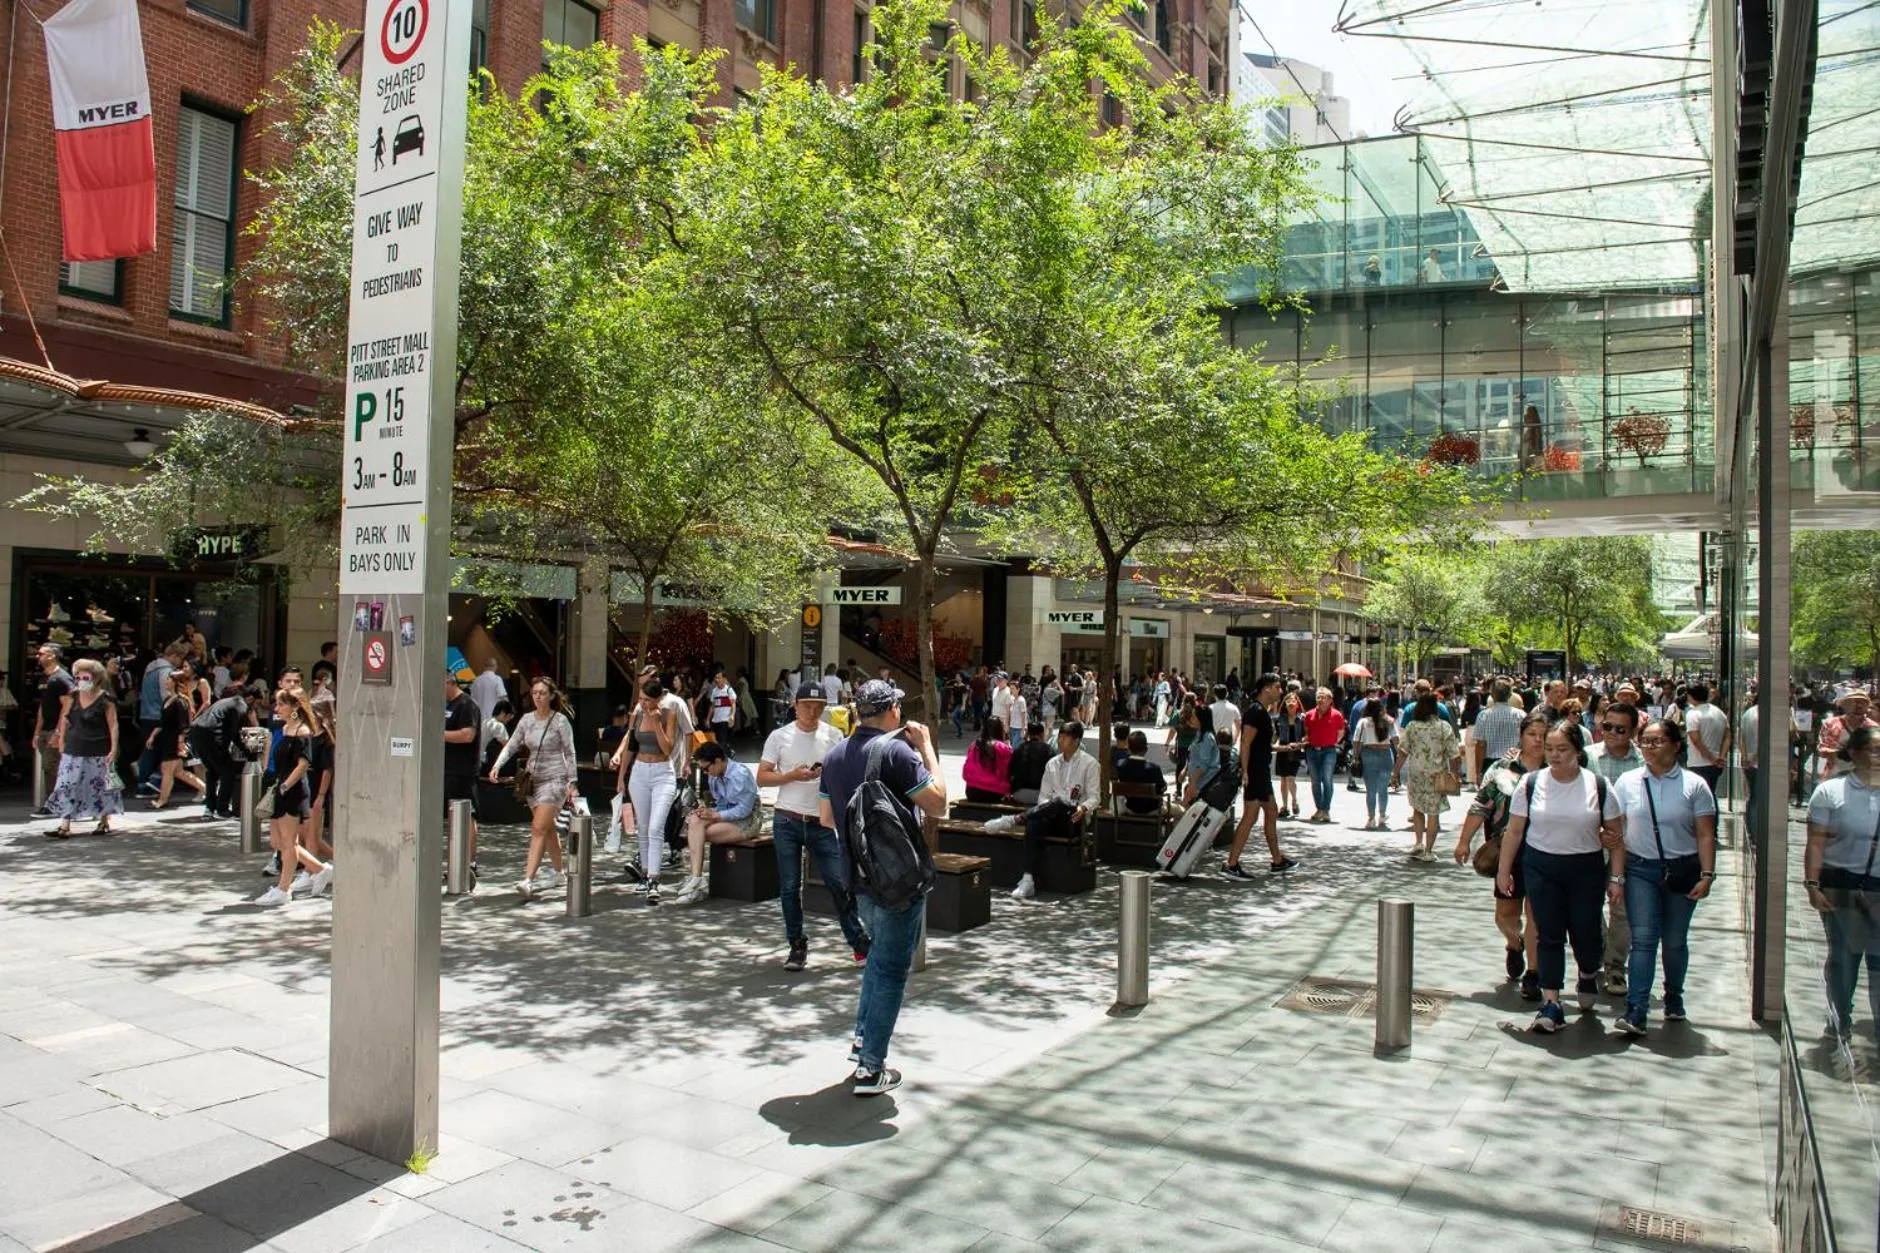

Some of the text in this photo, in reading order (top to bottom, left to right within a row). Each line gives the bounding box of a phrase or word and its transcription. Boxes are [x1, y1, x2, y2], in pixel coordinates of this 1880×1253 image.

[393, 6, 416, 44] 10
[376, 62, 425, 98] SHARED
[79, 101, 138, 124] MYER
[383, 86, 416, 114] ZONE
[367, 201, 423, 239] GIVE WAY
[387, 243, 399, 264] TO
[362, 267, 423, 300] PEDESTRIANS
[351, 331, 429, 363] PITT STREET MALL
[353, 353, 425, 383] PARKING AREA 2
[354, 387, 404, 442] P 15
[379, 425, 403, 440] MINUTE
[353, 456, 375, 491] 3AM
[393, 451, 417, 487] 8AM
[198, 535, 242, 555] HYPE
[355, 524, 411, 545] PARK IN
[350, 551, 416, 573] BAYS ONLY
[833, 589, 889, 602] MYER
[1048, 612, 1094, 623] MYER
